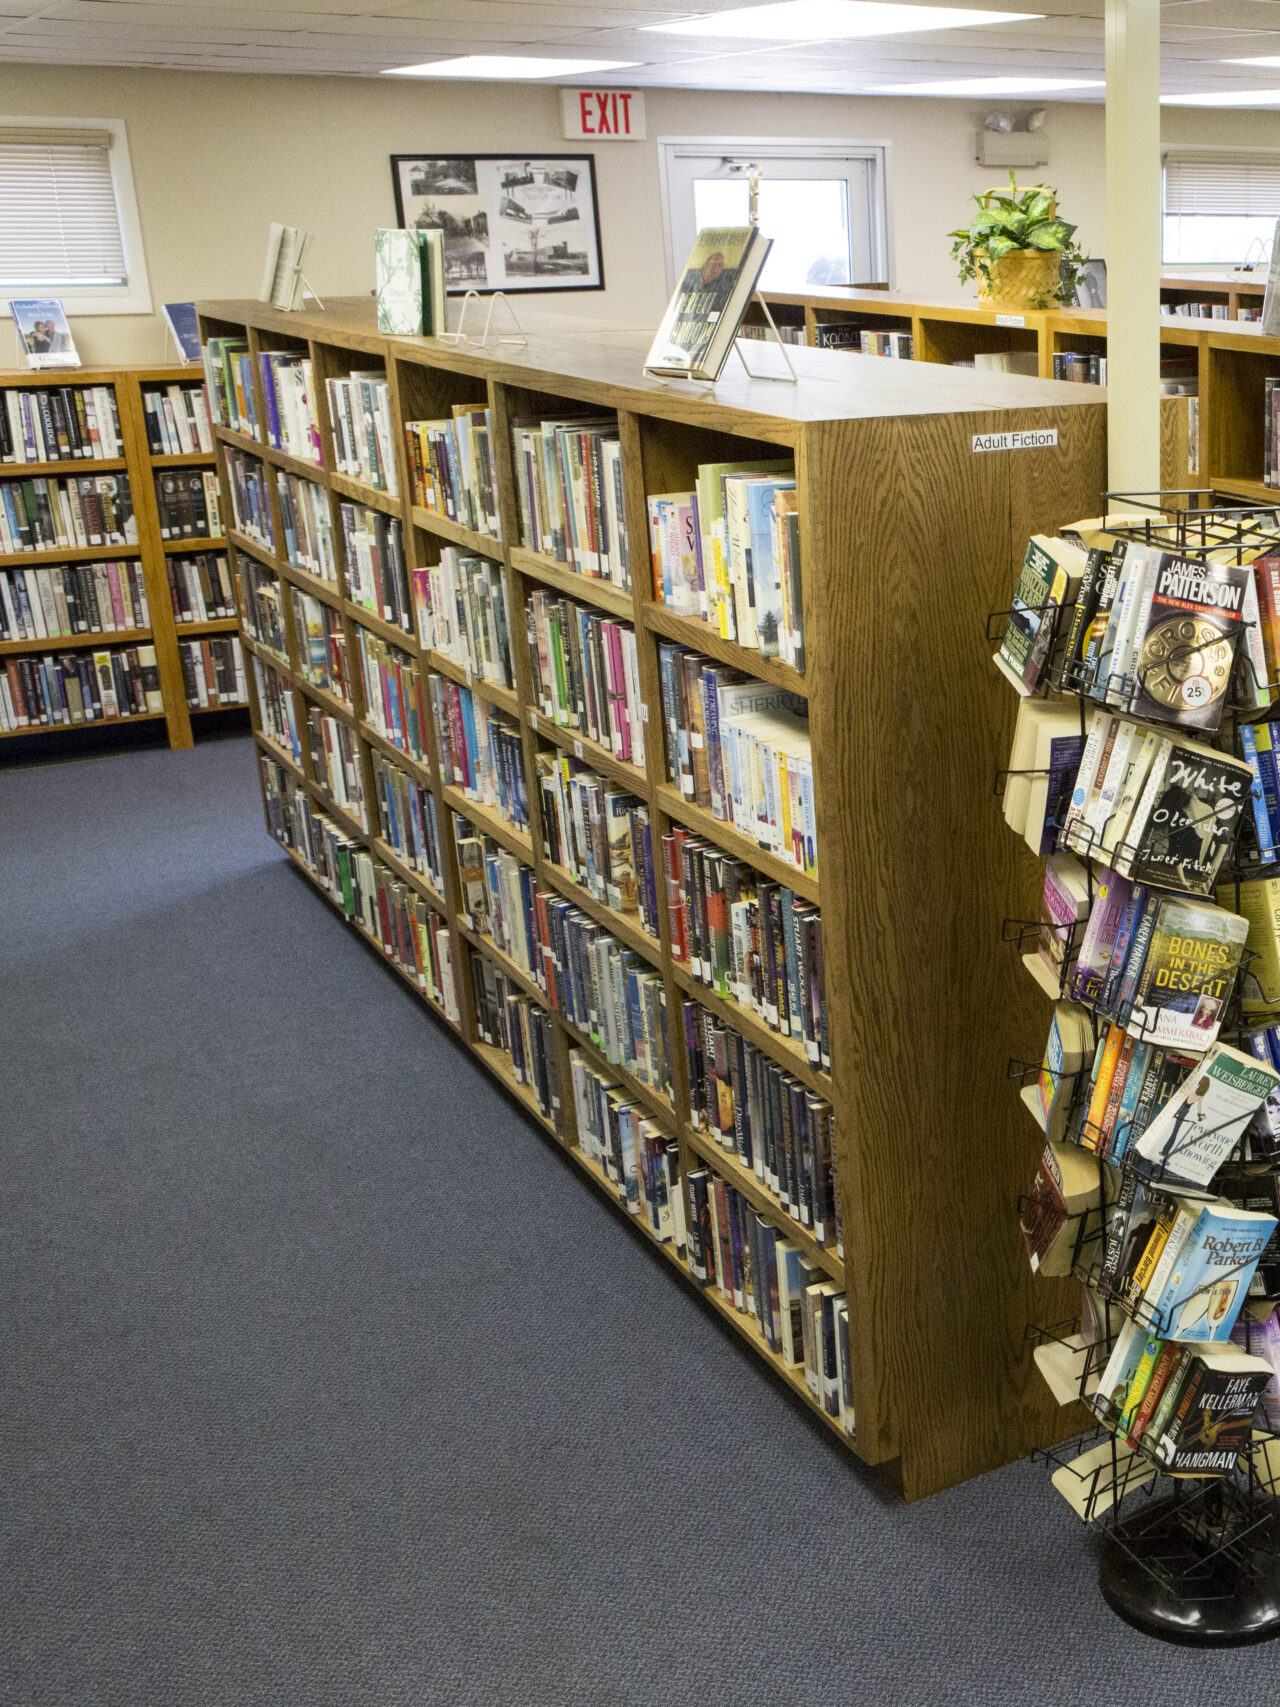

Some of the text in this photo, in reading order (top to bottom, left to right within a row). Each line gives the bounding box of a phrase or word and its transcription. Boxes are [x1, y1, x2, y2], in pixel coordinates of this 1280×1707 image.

[580, 92, 632, 134] EXIT
[680, 292, 717, 313] PERFECT
[974, 433, 1053, 450] Adult Fiction
[1077, 561, 1092, 603] GRAFTON
[1167, 560, 1206, 580] JAMES
[1270, 570, 1280, 589] DALE
[1100, 565, 1116, 608] LESCROART
[1110, 577, 1118, 598] JOHN
[1158, 571, 1241, 610] PATTERSON
[1168, 598, 1180, 606] NEW
[1180, 600, 1194, 608] ALEX
[1149, 621, 1226, 663] CROSS
[1187, 686, 1201, 698] 25
[1169, 759, 1242, 798] White
[1141, 848, 1213, 875] Janet Fitch
[793, 916, 802, 957] STUART
[1127, 916, 1153, 982] KAREN HARPER
[1169, 937, 1229, 963] BONES
[1169, 958, 1216, 975] IN THE
[1155, 968, 1227, 998] DESERT
[706, 1017, 715, 1059] STUART
[1139, 1070, 1154, 1104] HARPER
[1211, 1065, 1271, 1098] WEISBERGER
[1240, 1067, 1277, 1088] LAUREN
[1136, 1227, 1165, 1284] Linwood Barclay
[1202, 1235, 1247, 1251] Robert
[1205, 1251, 1252, 1267] Parker
[1225, 1377, 1252, 1393] FAYE
[1199, 1392, 1259, 1410] KELLERMAN
[1175, 1452, 1237, 1469] HANGMAN
